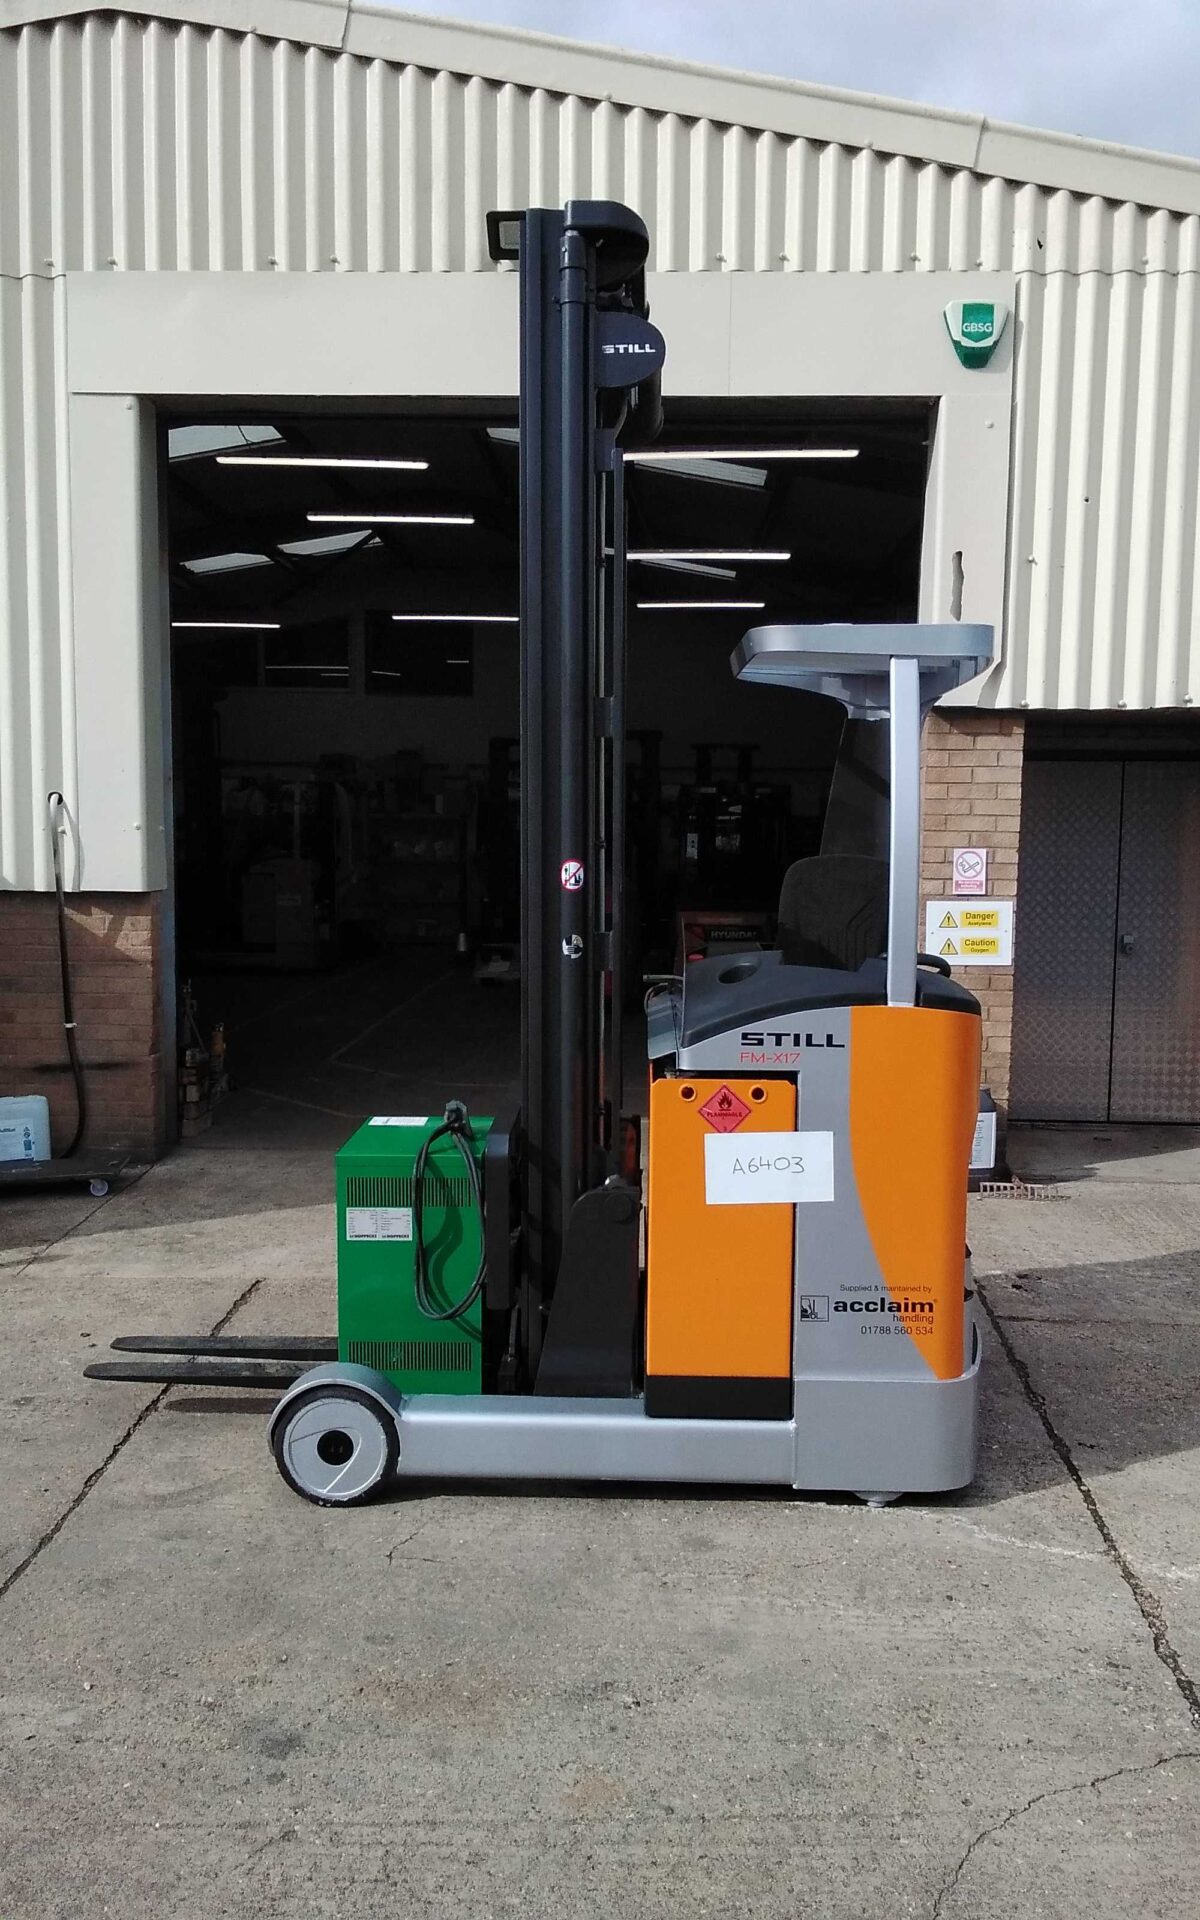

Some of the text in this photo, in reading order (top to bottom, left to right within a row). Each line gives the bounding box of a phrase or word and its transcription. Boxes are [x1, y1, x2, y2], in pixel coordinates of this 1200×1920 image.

[962, 322, 992, 332] GBSG
[602, 343, 656, 353] STILL
[965, 912, 995, 921] Danger
[741, 1032, 845, 1048] STILL
[740, 1052, 801, 1064] FM-X17
[732, 1156, 805, 1175] A6403
[839, 1284, 872, 1293] Supplied
[881, 1284, 921, 1292] maintained
[922, 1284, 932, 1294] by
[833, 1297, 934, 1313] acclaim
[892, 1314, 934, 1324] handling
[860, 1326, 933, 1335] 01788 560 534
